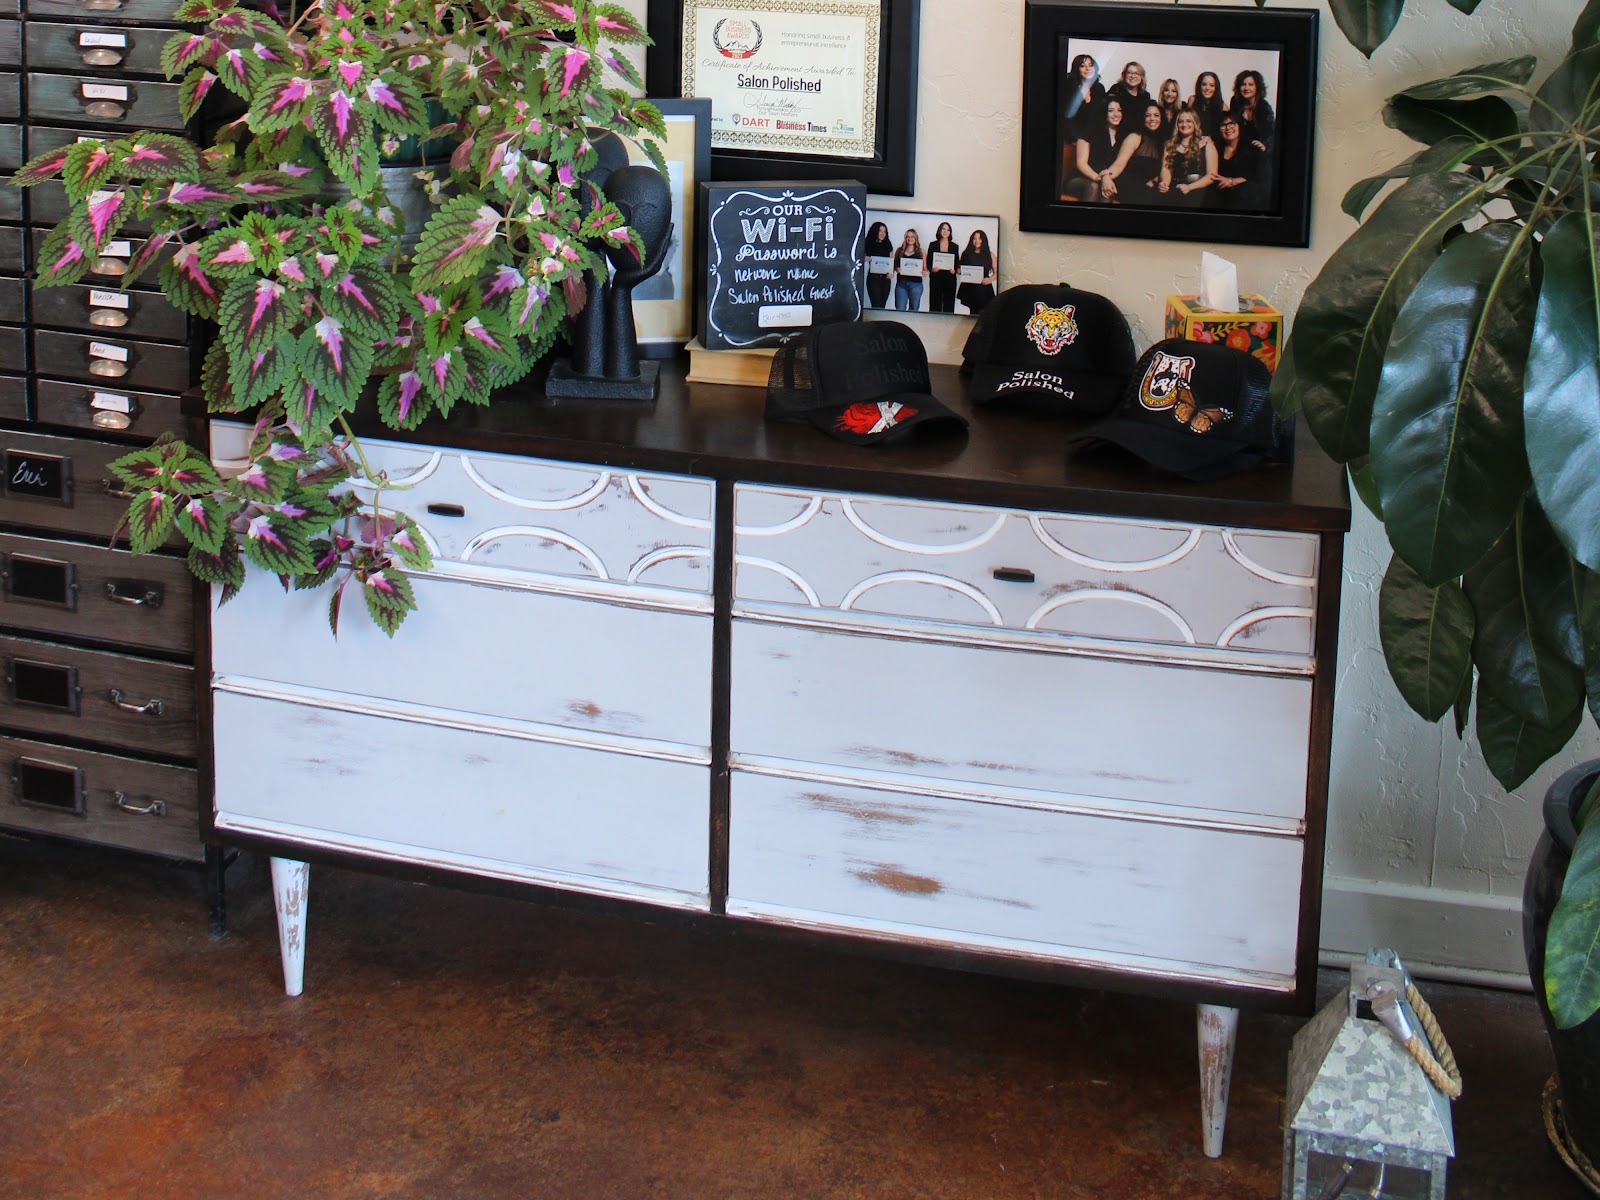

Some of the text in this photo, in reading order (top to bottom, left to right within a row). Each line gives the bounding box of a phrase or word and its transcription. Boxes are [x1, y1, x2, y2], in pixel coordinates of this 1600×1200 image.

[725, 26, 751, 34] BUSINESS
[730, 20, 748, 28] SMALL
[726, 32, 750, 40] AWARDS
[781, 31, 806, 40] Honoring
[780, 40, 820, 49] entrepreneurial
[701, 58, 742, 72] Certificate
[743, 62, 752, 72] of
[752, 62, 802, 74] Achievement
[804, 65, 844, 76] Awarded
[737, 73, 822, 92] Salon Polished
[742, 116, 770, 128] DART
[776, 119, 806, 132] Business
[808, 122, 827, 134] Times
[772, 205, 803, 216] OUR
[740, 215, 834, 244] Wi-Fi
[735, 243, 838, 262] Password is
[787, 268, 818, 281] name
[728, 284, 835, 304] Salon Polished Guest
[854, 332, 909, 354] Salon
[1012, 370, 1063, 386] Salon
